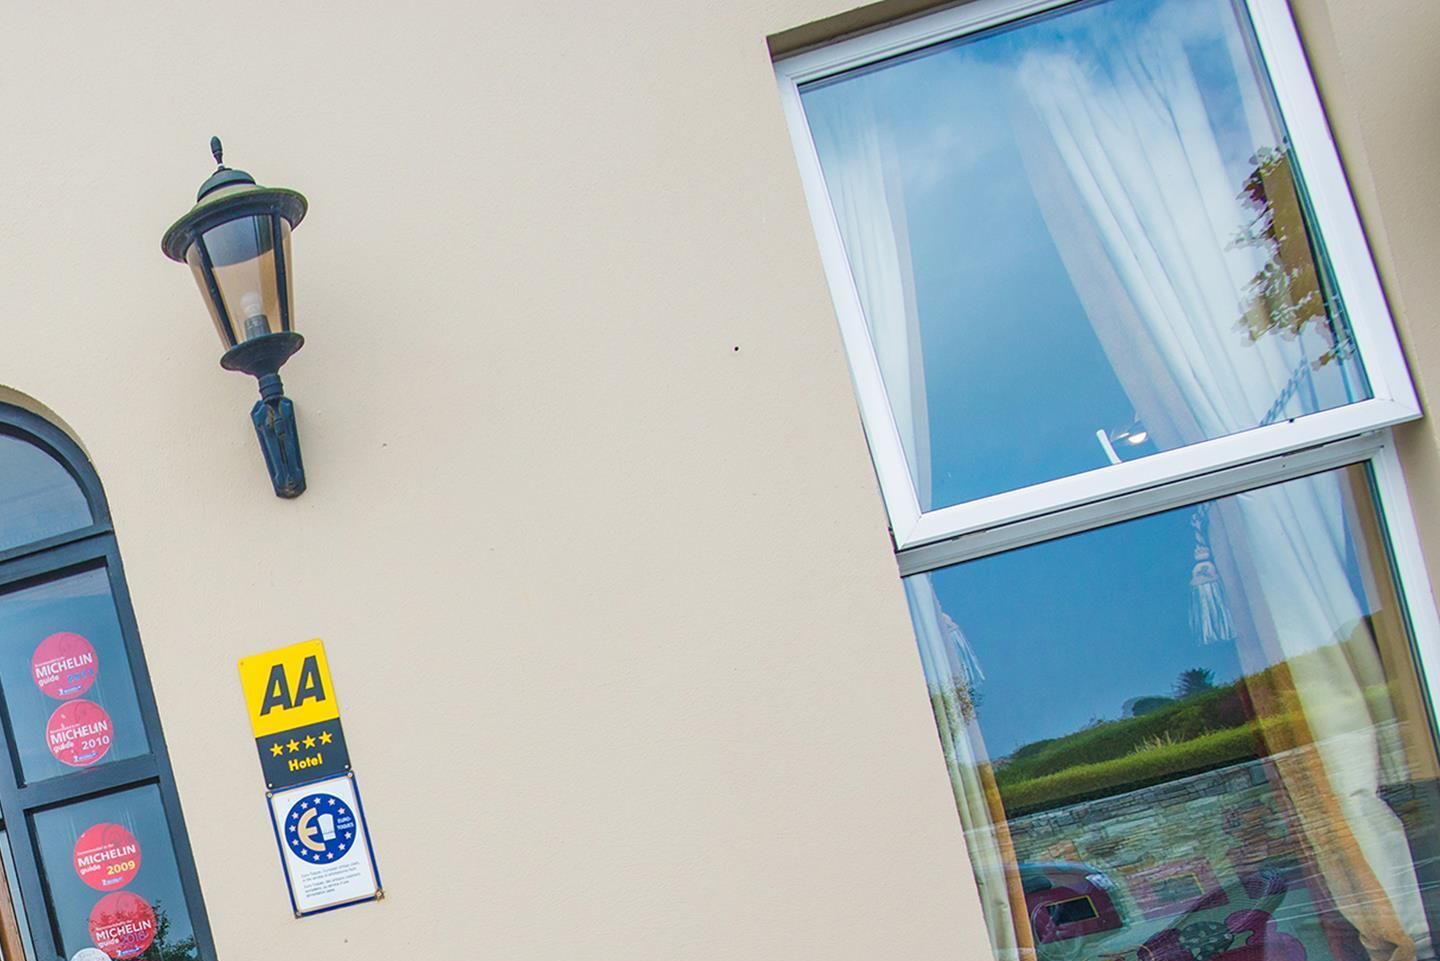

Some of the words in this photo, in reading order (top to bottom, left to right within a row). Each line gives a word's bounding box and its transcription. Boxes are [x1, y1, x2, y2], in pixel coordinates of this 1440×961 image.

[34, 652, 93, 680] MICHELIN
[38, 673, 60, 687] guide
[259, 655, 326, 716] AA
[49, 720, 108, 746] MICHELIN
[53, 741, 74, 754] guide
[81, 735, 110, 751] 2010
[287, 753, 323, 772] Hotel
[77, 843, 136, 868] MICHELIN
[79, 863, 102, 876] guide
[106, 860, 136, 876] 2009
[95, 919, 152, 942] MICHELIN
[98, 937, 120, 949] guide
